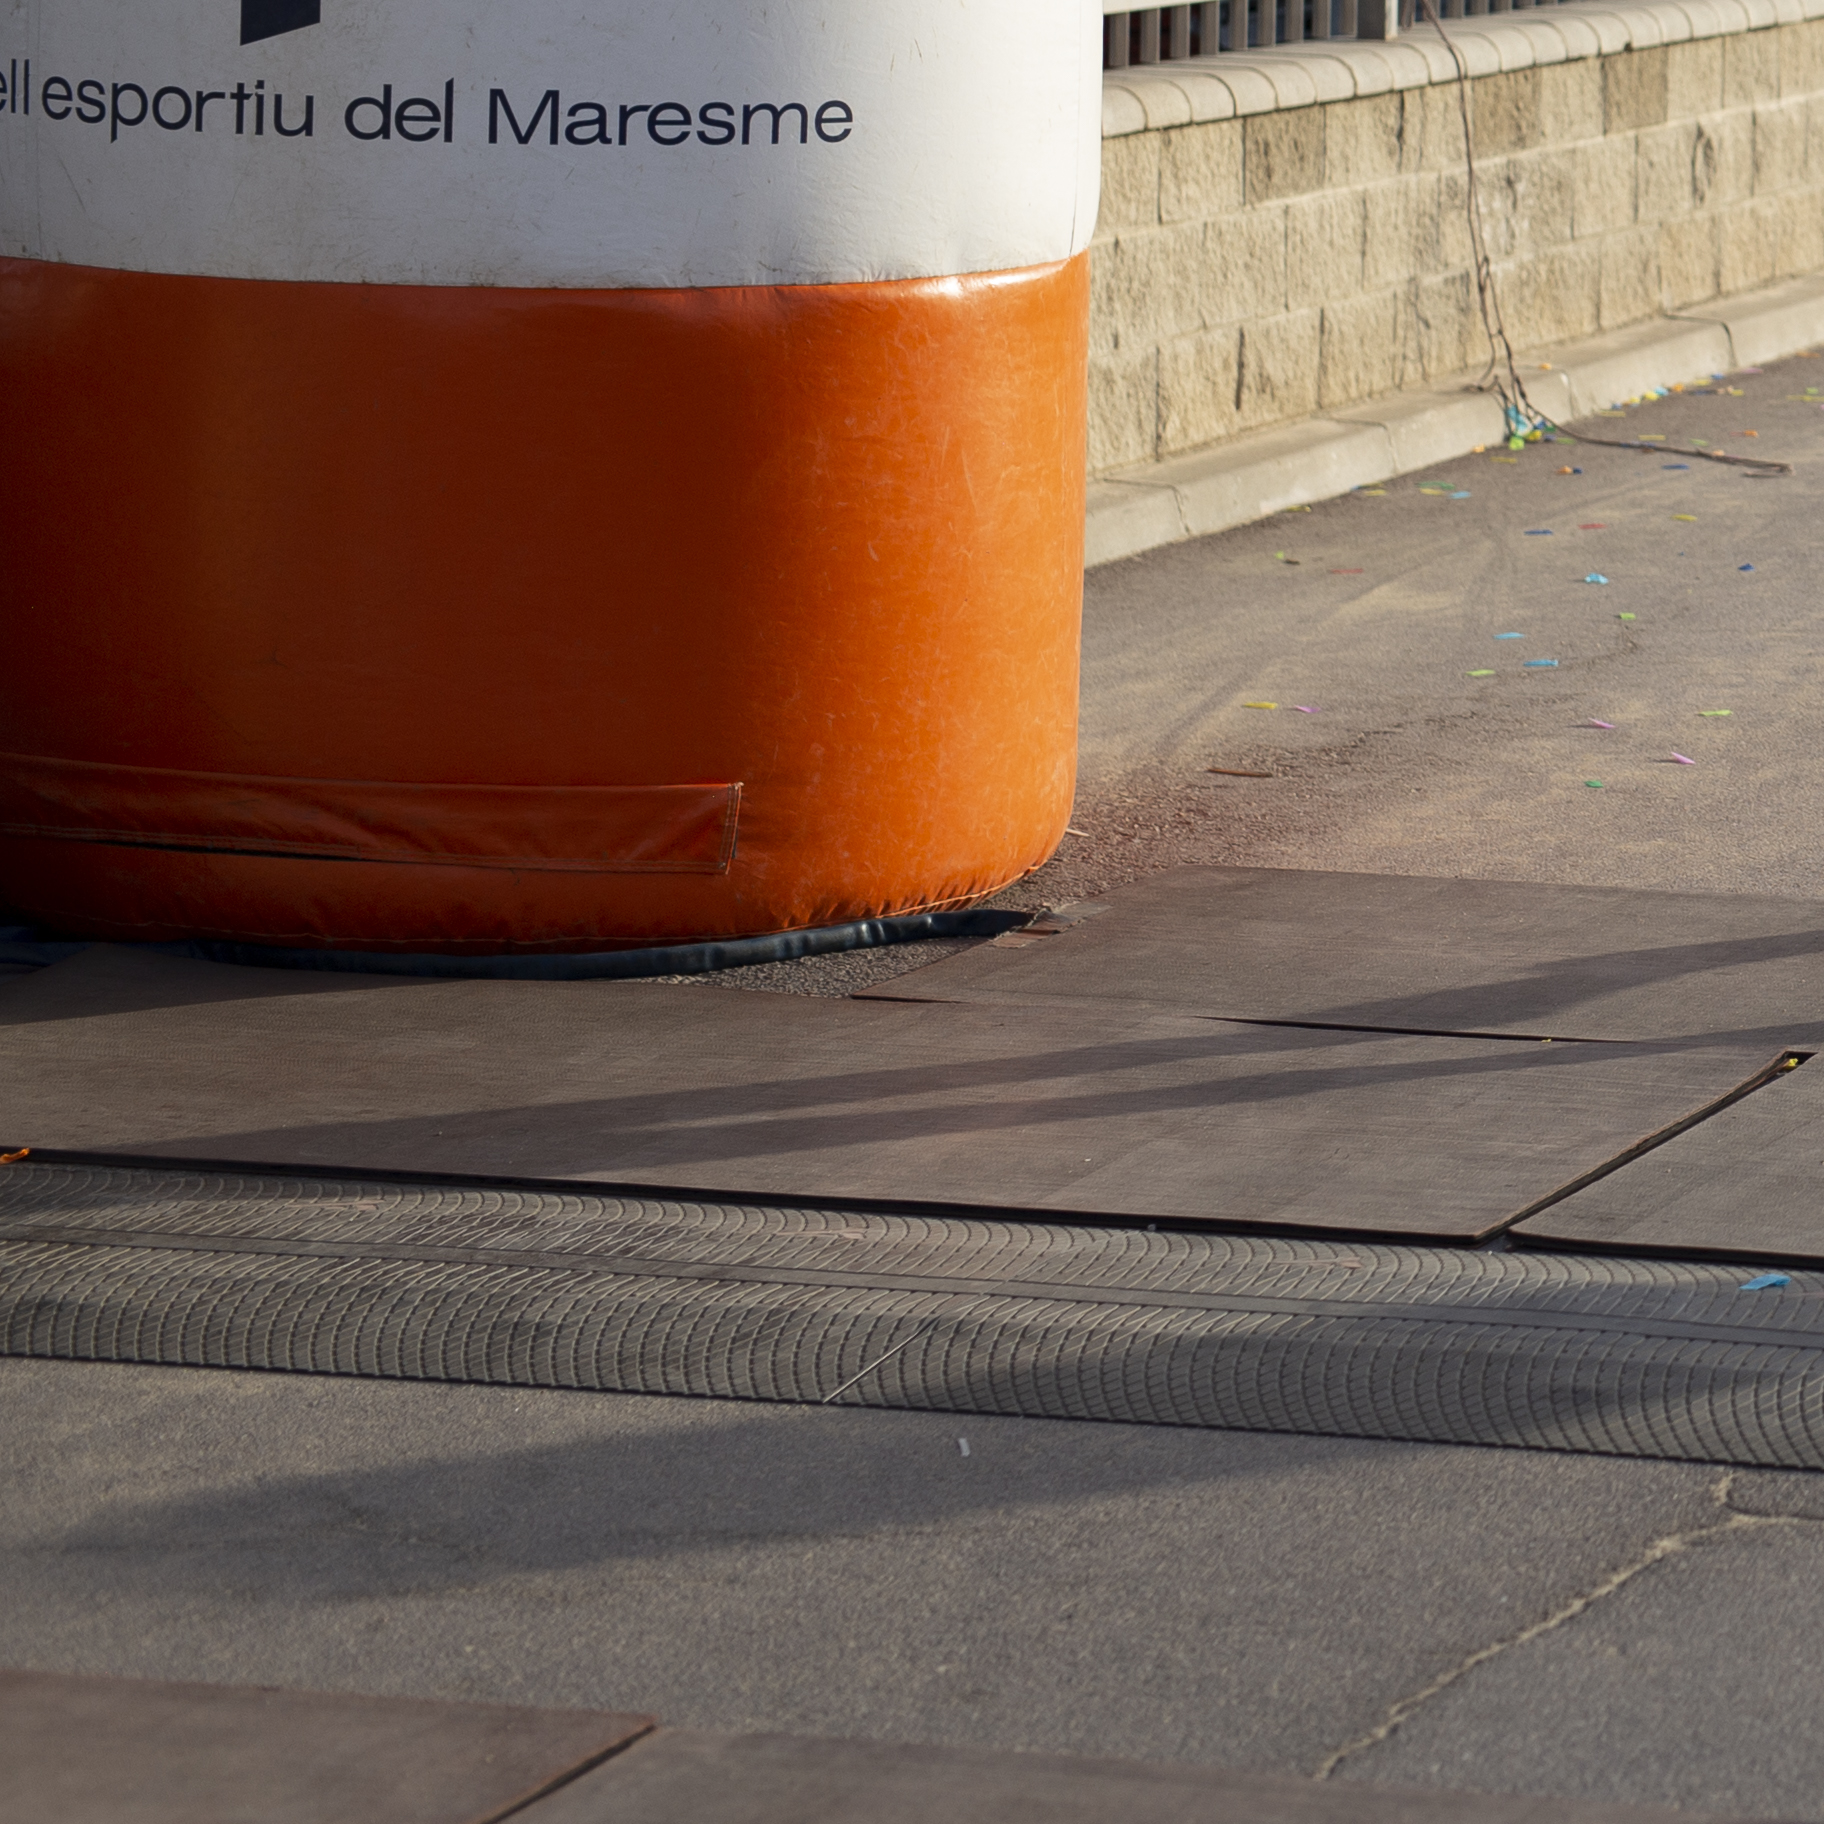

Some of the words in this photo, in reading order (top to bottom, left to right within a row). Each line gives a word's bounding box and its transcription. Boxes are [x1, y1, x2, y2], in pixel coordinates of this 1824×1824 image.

[41, 69, 316, 143] esportiu
[343, 76, 454, 143] del
[487, 85, 855, 147] Maresme
